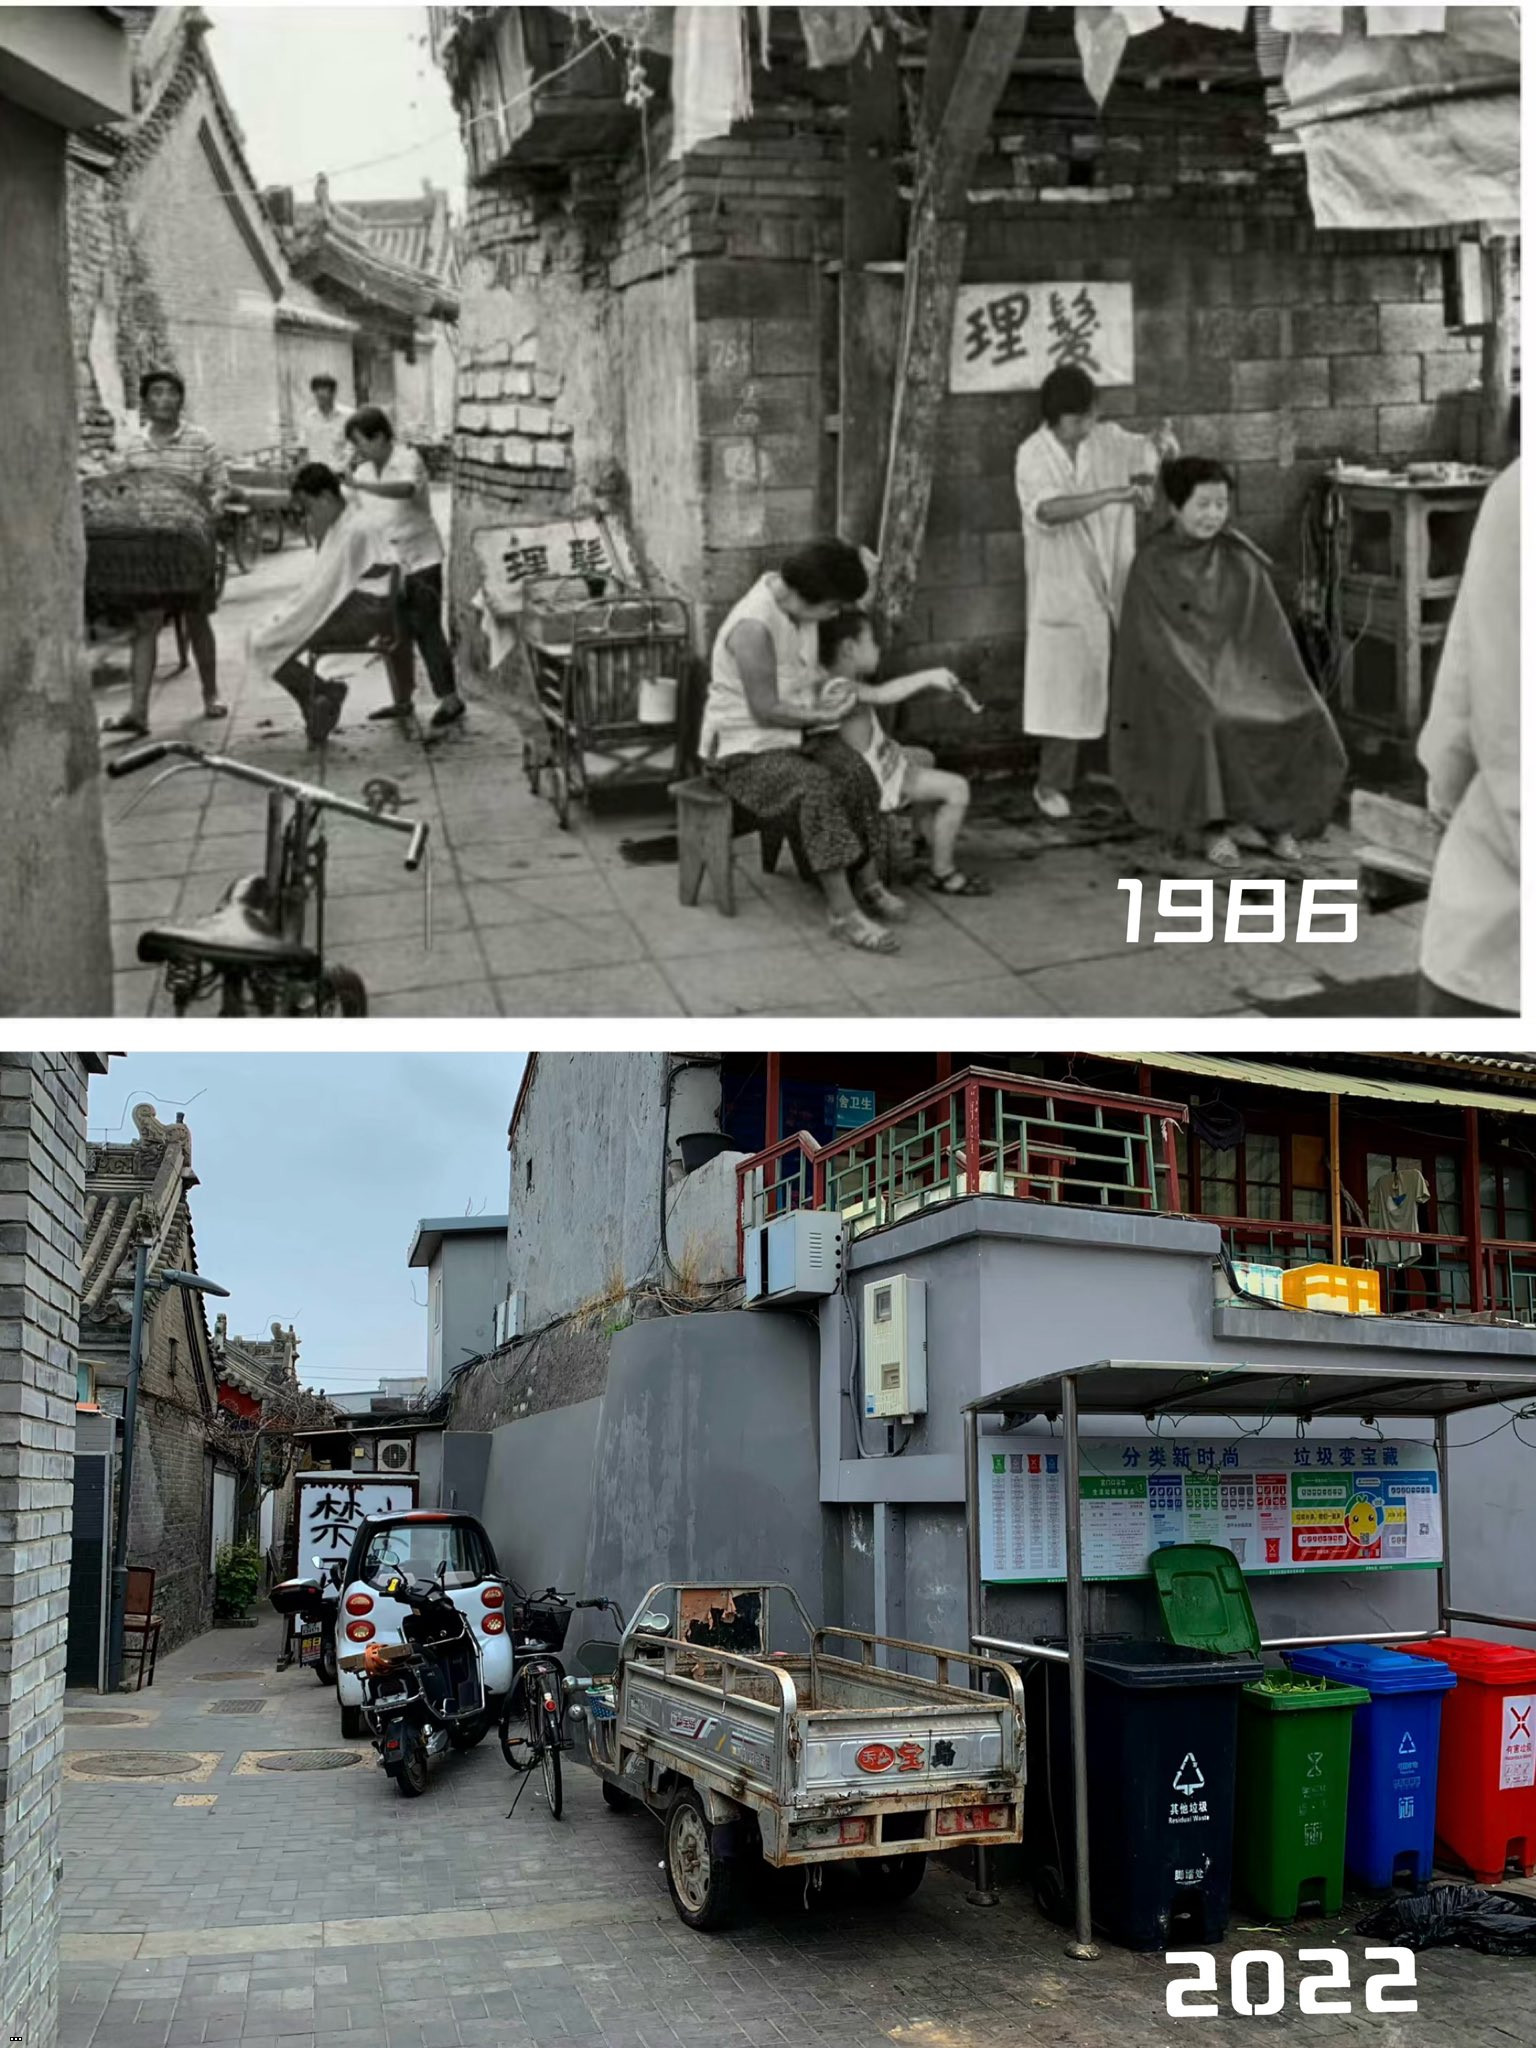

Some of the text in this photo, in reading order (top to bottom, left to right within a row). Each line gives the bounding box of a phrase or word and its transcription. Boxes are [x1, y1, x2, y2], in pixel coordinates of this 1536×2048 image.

[1122, 1446, 1399, 1468] 分类新时尚 垃圾变宝藏
[1170, 1801, 1208, 1815] 其他垃圾
[1168, 1814, 1210, 1824] Residual Waste
